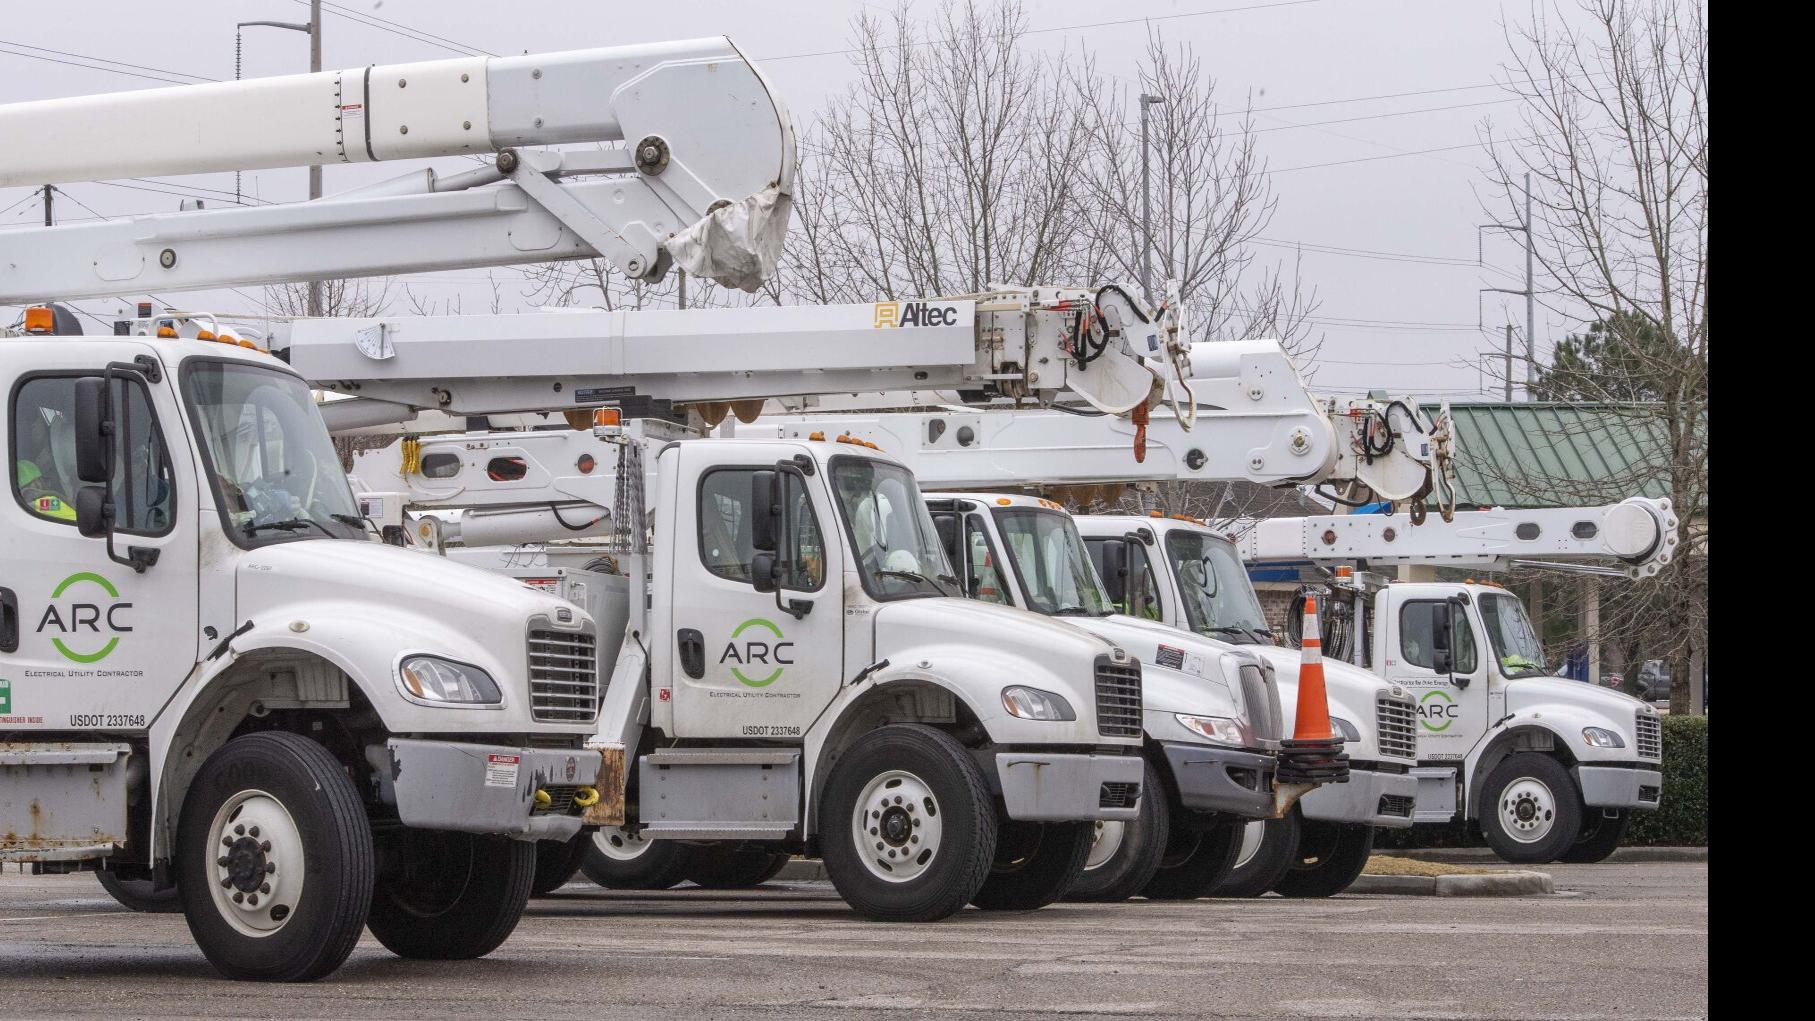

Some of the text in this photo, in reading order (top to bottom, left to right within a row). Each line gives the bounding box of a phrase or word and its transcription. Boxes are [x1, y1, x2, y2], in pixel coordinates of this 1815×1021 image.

[899, 303, 957, 327] Altec
[36, 603, 133, 632] ARC
[719, 642, 794, 664] ARC
[70, 714, 145, 726] USDOT 2337648
[1416, 704, 1459, 718] ARC
[742, 725, 800, 735] USDOT 2337648
